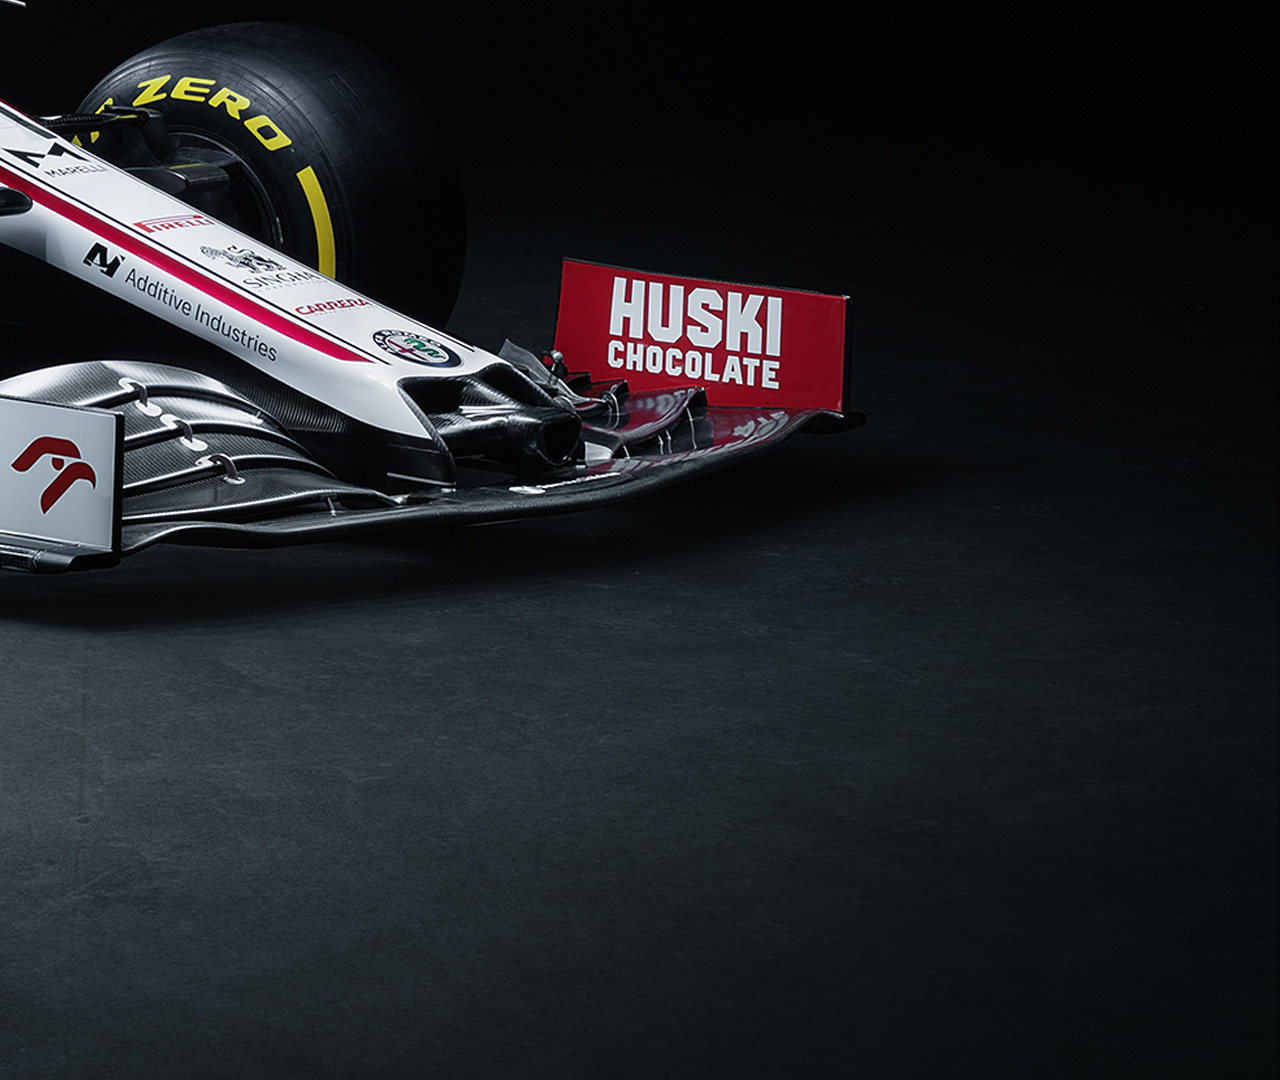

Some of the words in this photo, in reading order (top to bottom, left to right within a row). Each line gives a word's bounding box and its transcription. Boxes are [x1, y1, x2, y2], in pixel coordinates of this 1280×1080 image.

[133, 74, 293, 152] ZERO
[132, 214, 216, 234] PIRELLI
[243, 270, 322, 289] SINGHA
[125, 268, 192, 317] Additive
[195, 304, 278, 363] Industries
[295, 297, 371, 316] CARRERA
[608, 276, 783, 357] HUSKI
[606, 340, 781, 390] CHOCOLATE
